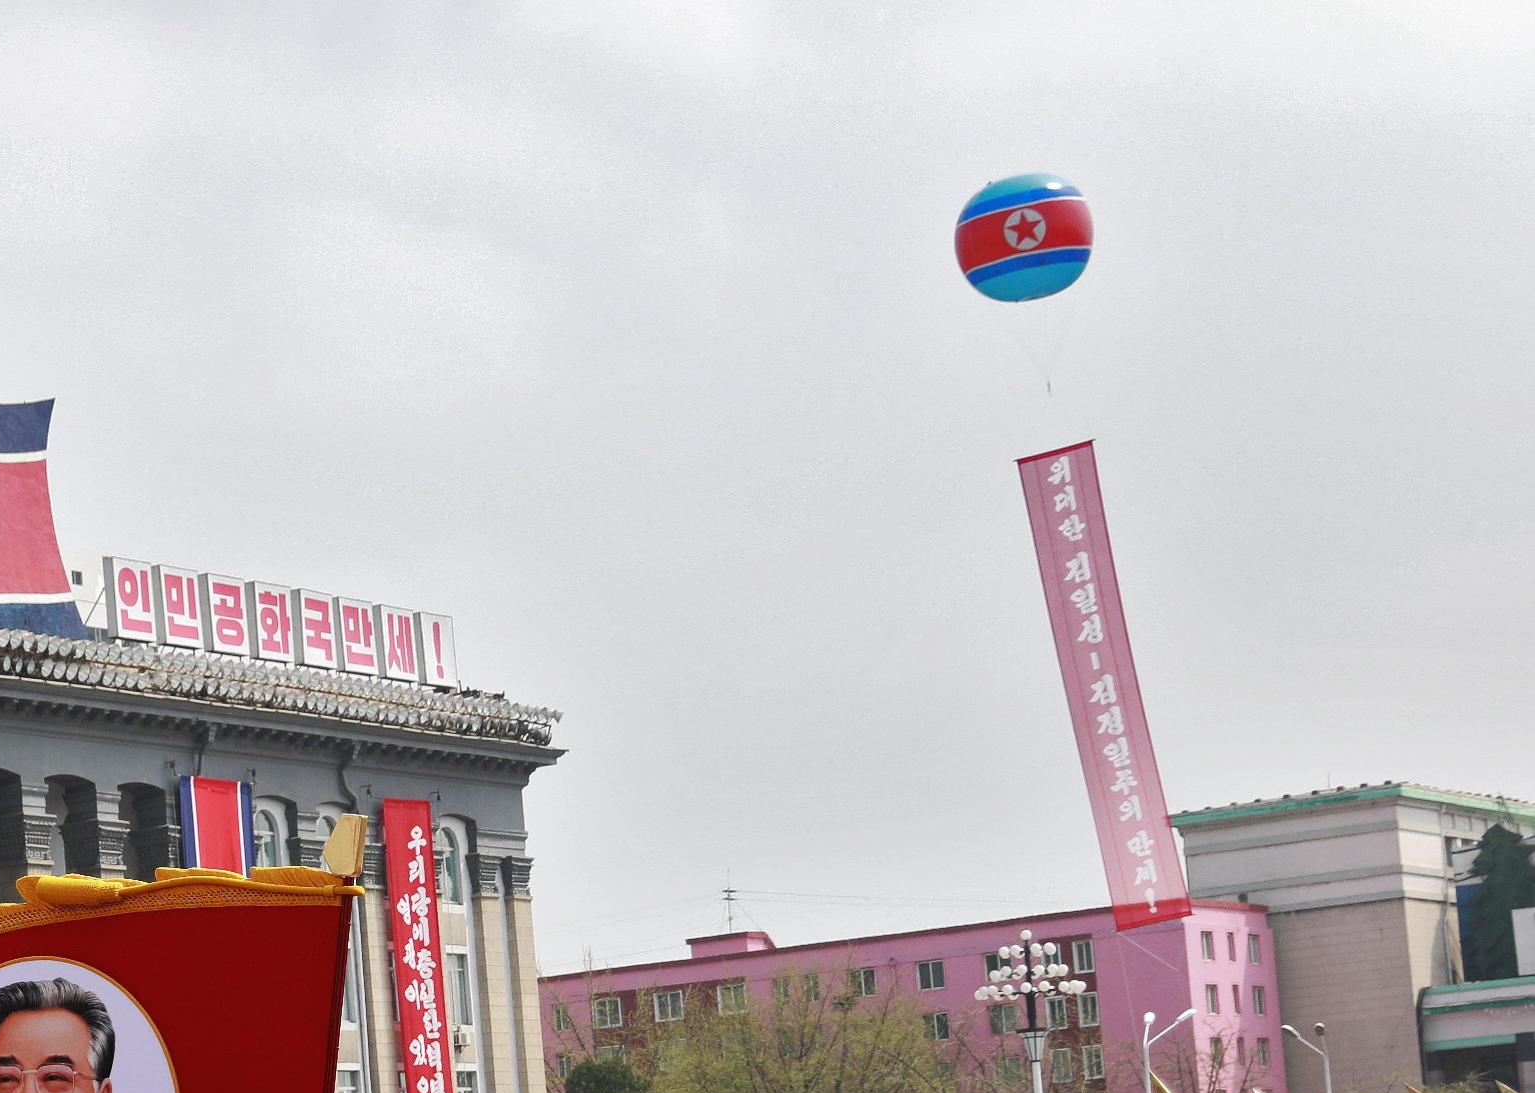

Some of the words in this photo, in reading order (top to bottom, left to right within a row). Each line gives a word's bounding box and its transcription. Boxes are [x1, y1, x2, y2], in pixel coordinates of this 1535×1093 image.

[117, 567, 444, 679] 인민공화국만세!
[1047, 455, 1086, 542] 위대한
[1126, 830, 1158, 914] 만세!
[396, 893, 421, 1011] 영광이
[416, 949, 442, 1039] 충실한
